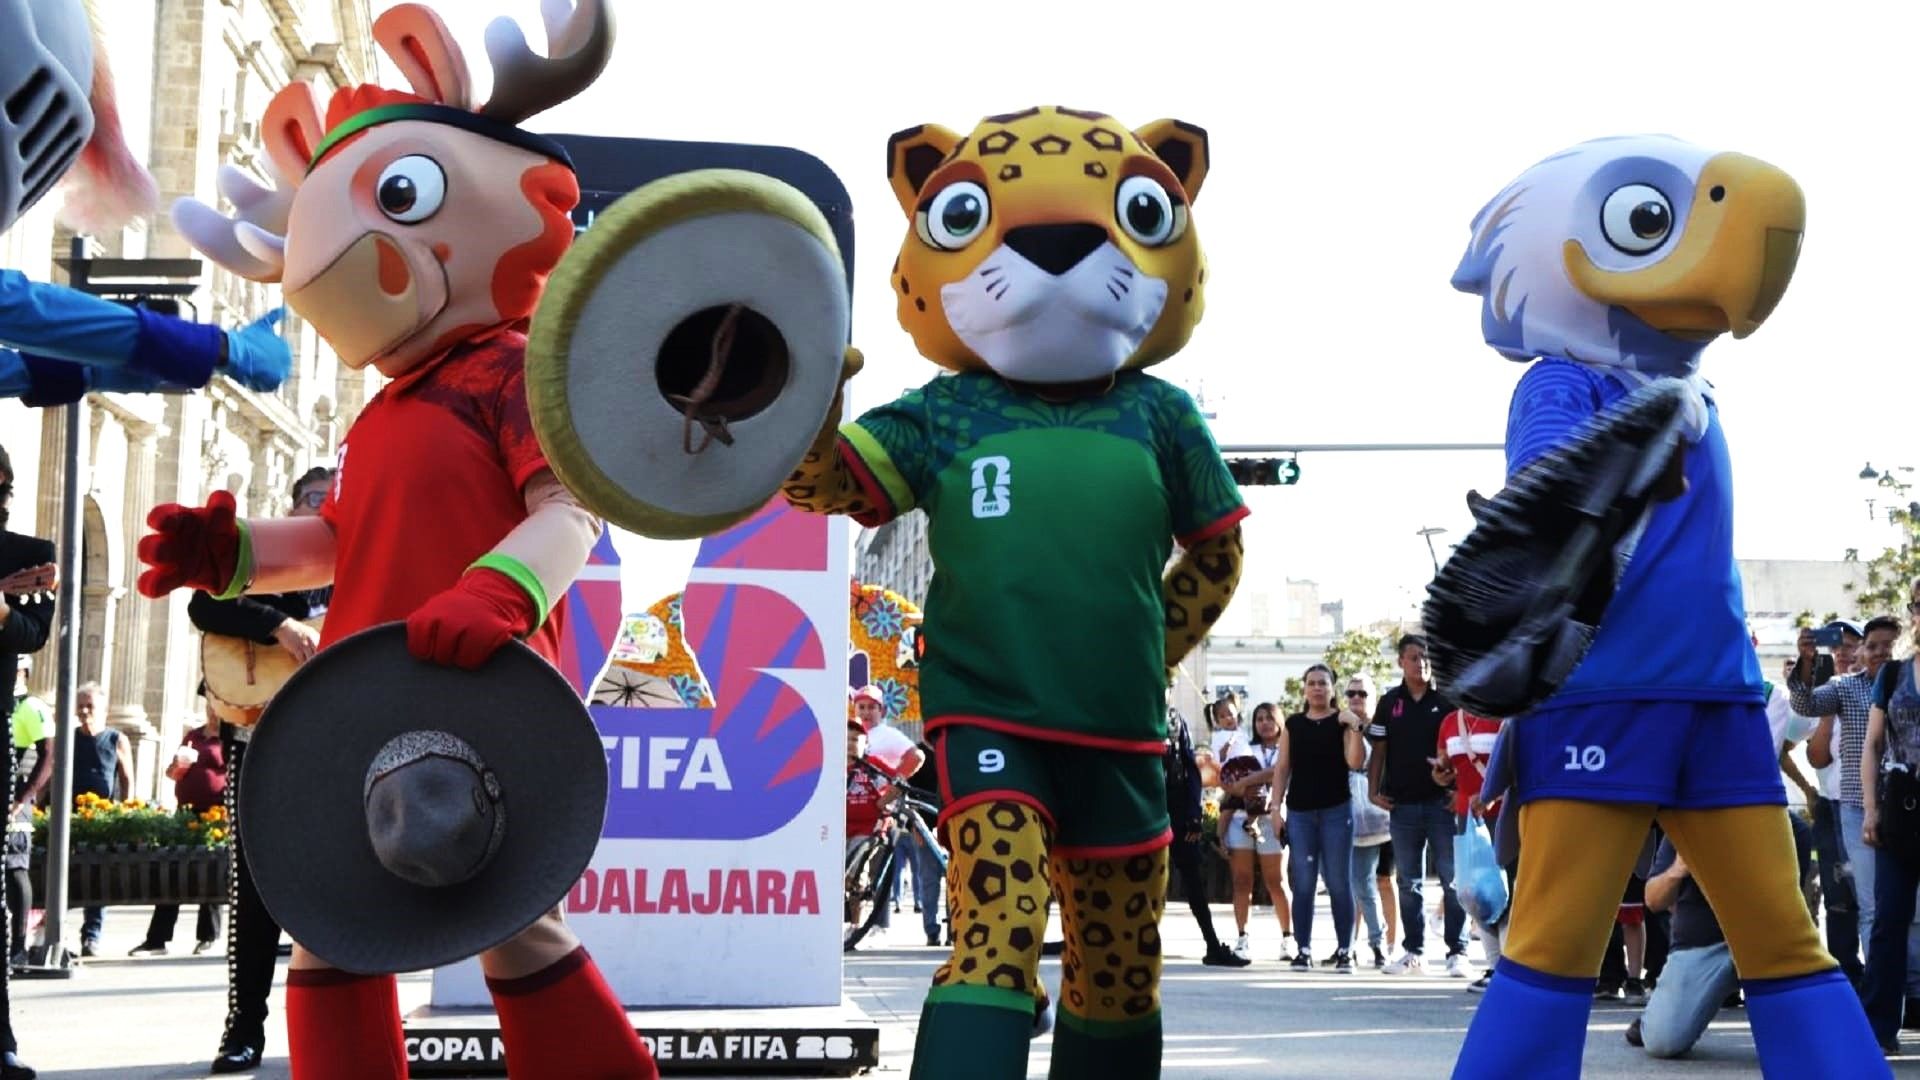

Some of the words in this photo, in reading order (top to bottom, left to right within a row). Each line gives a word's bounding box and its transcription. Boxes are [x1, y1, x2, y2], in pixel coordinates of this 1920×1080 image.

[978, 748, 1005, 773] 9
[1564, 745, 1606, 772] 10
[565, 868, 820, 914] DALAJARA
[404, 1036, 485, 1062] COPA
[680, 1035, 719, 1060] LA
[723, 1035, 789, 1060] FIFA
[795, 1035, 853, 1059] 26
